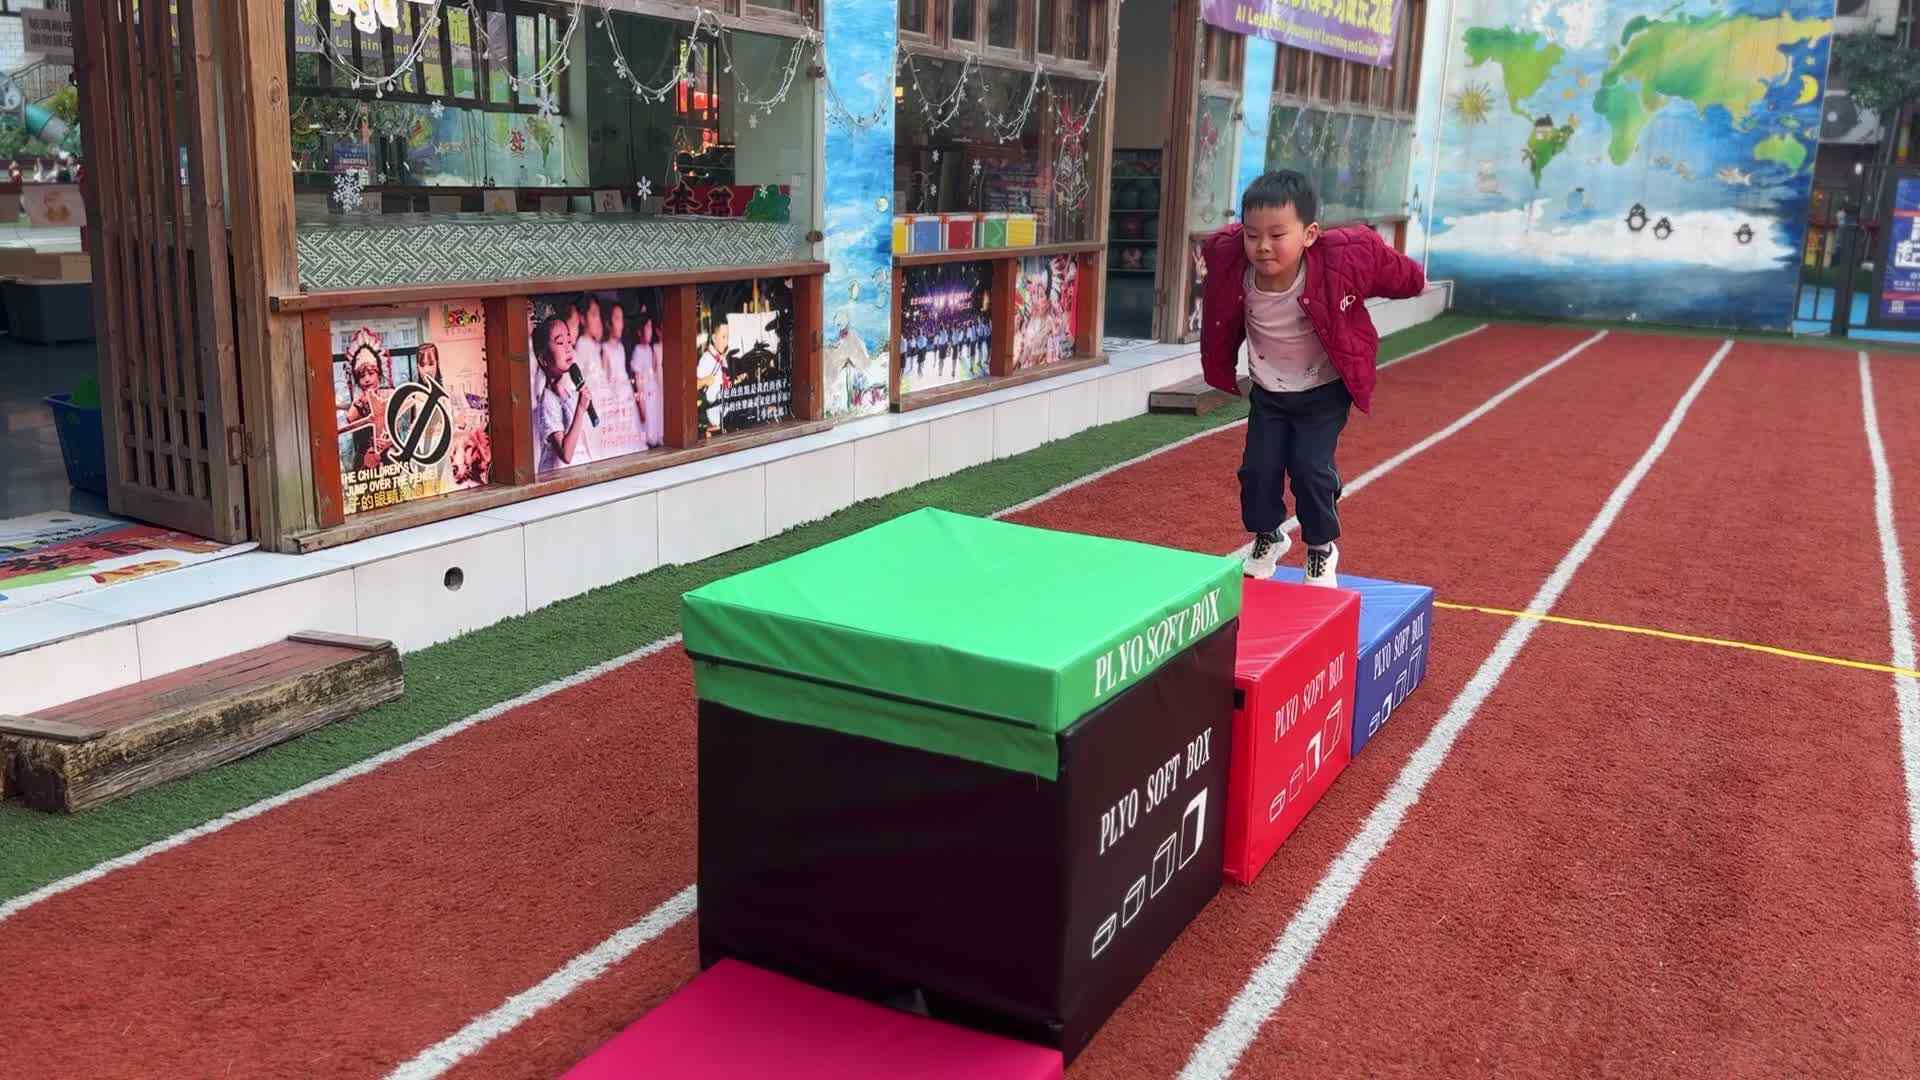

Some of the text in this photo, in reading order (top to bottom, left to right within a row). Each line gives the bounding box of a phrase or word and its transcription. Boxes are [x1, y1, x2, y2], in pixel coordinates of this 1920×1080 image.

[1094, 588, 1222, 698] PLYO SOFT BOX
[1373, 612, 1425, 681] PLYO SOFT BOX
[1274, 651, 1345, 744] PLYO SOFT BOX
[1100, 726, 1212, 856] PLYO SOFT BOX
